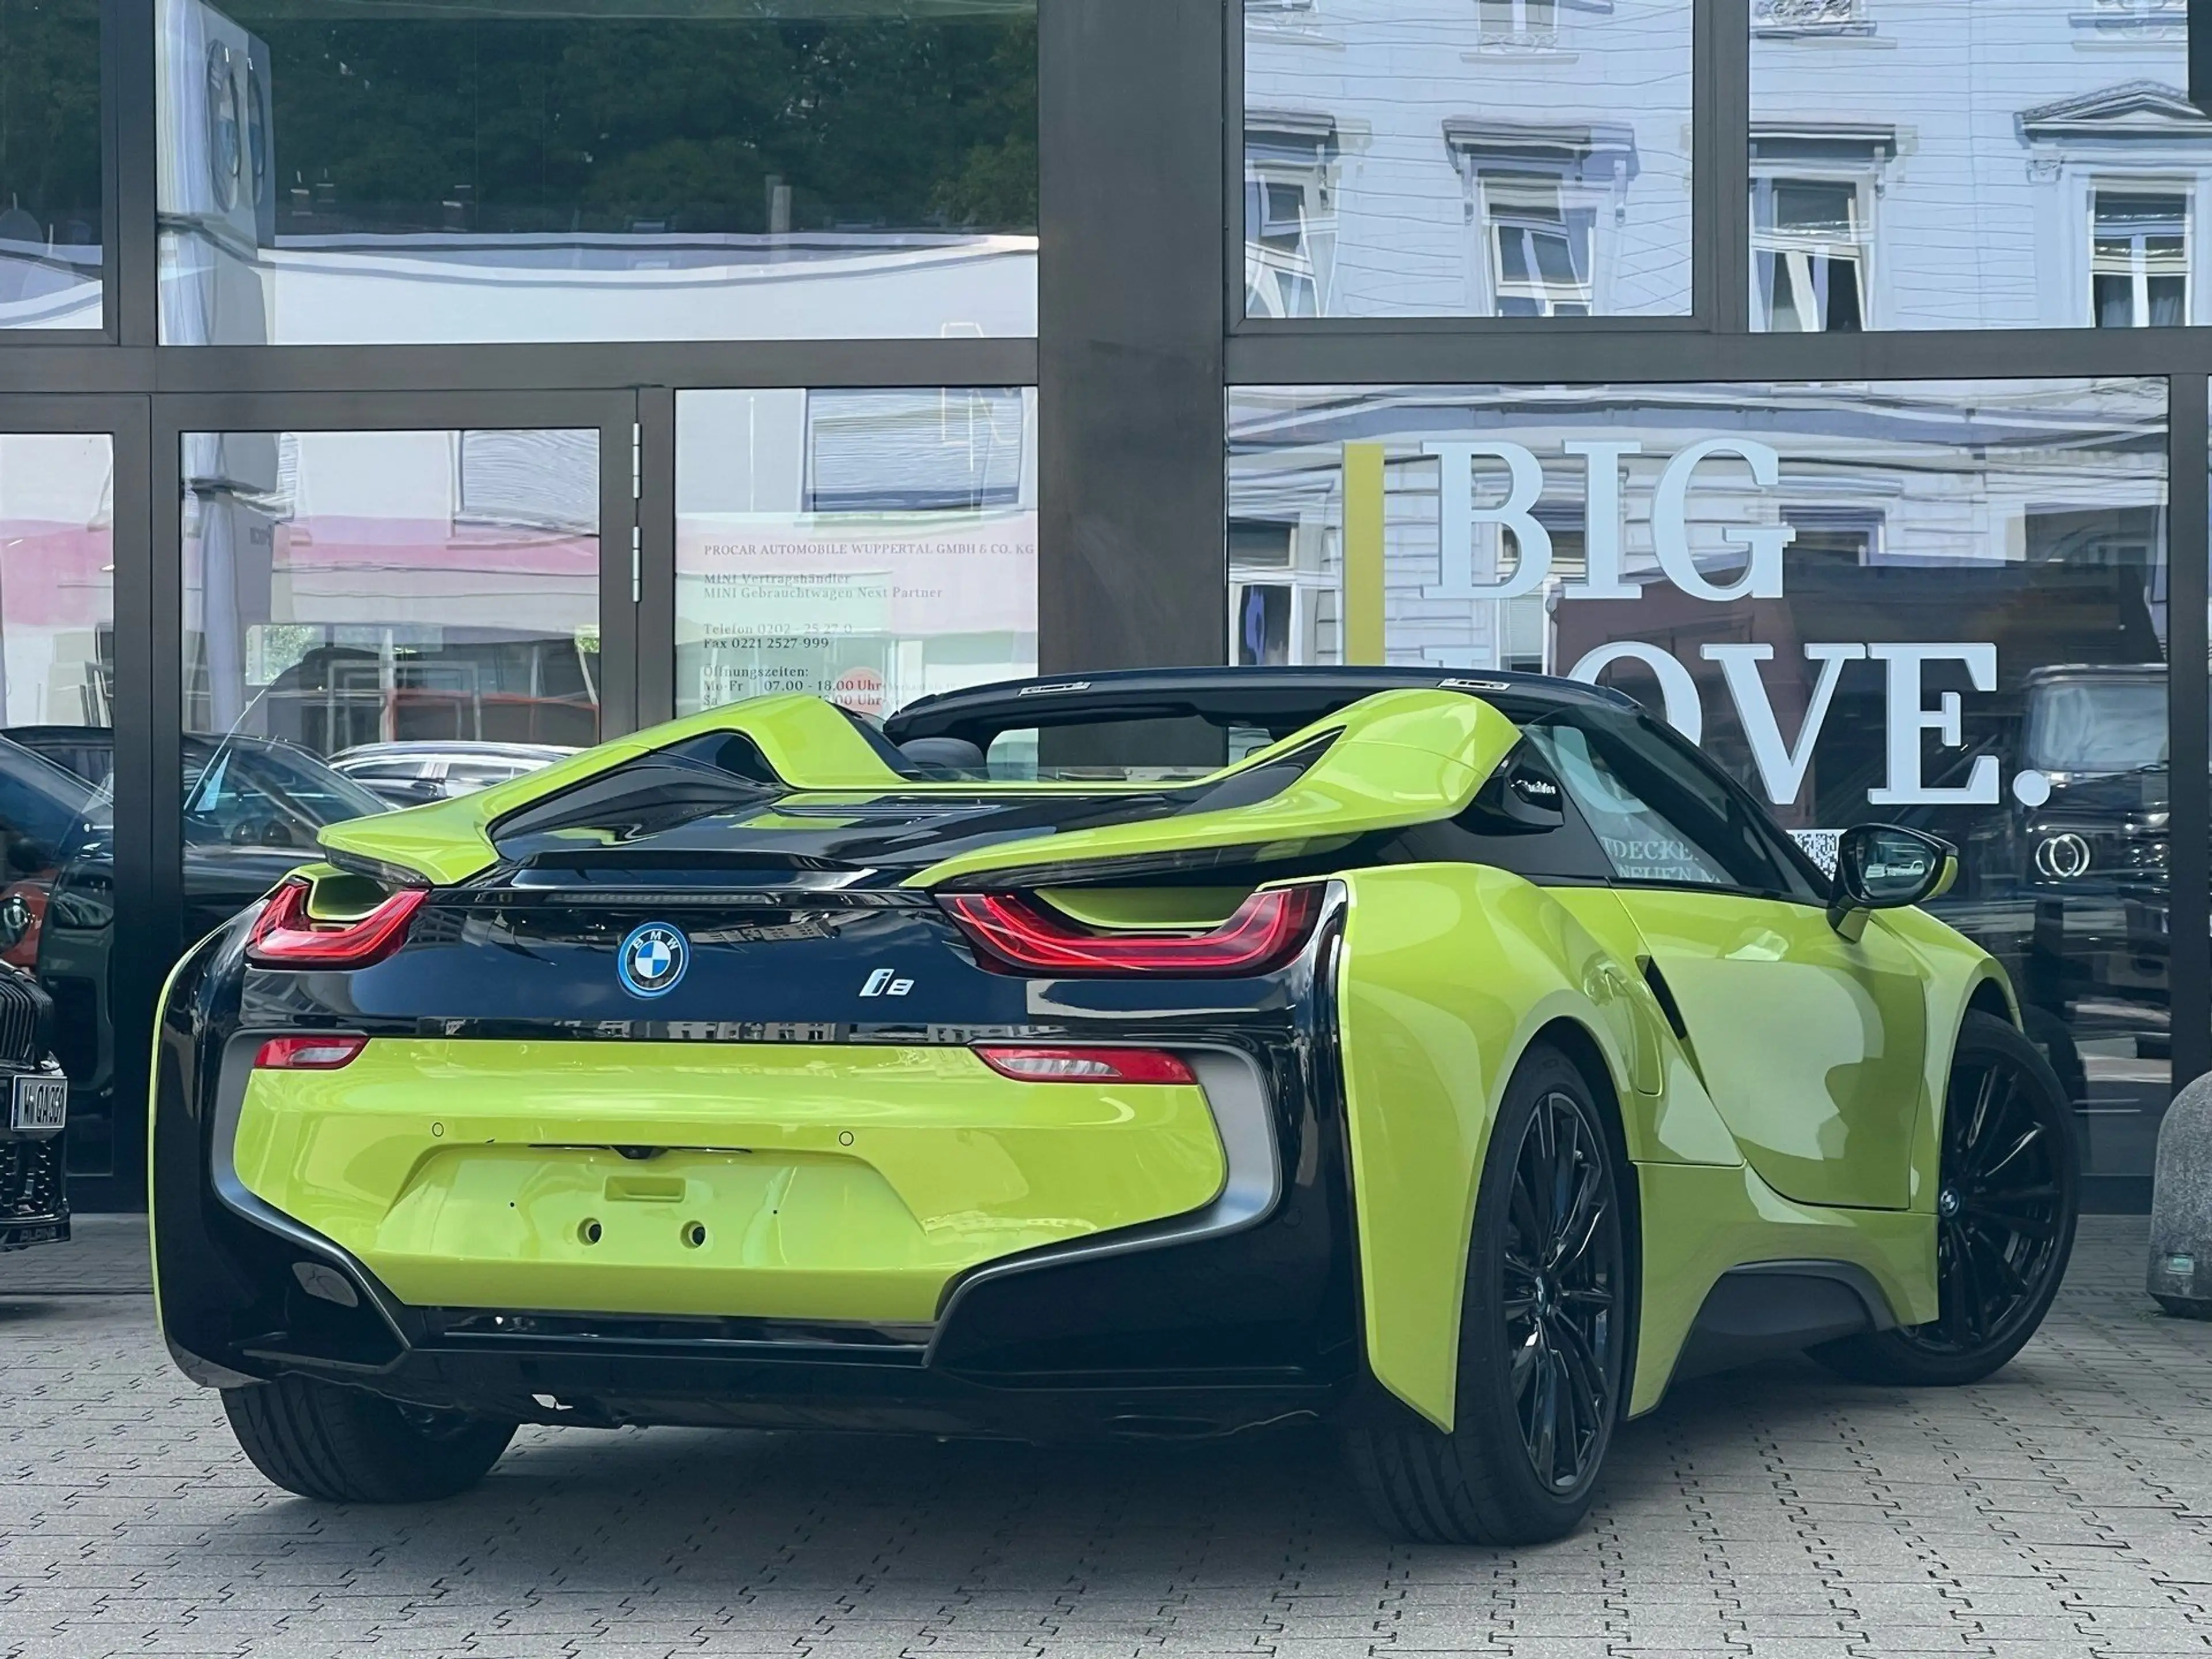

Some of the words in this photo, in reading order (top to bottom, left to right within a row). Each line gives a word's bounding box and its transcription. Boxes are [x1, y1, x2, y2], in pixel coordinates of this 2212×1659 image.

[1420, 438, 1796, 601] BIG
[704, 544, 756, 555] PROCAR
[760, 543, 847, 555] AUTOMOBILE
[851, 543, 933, 555] WUPPERTAL
[936, 543, 975, 555] GMBH
[979, 544, 987, 554] &
[990, 543, 1012, 555] CO.
[1016, 544, 1034, 555] KG
[704, 573, 737, 584] MINI
[741, 573, 851, 586] Vertragshändler
[704, 588, 737, 599] MINI
[741, 586, 853, 601] Gebrauchtwagen
[857, 587, 887, 599] Next
[892, 586, 943, 598] Partner
[703, 623, 753, 634] Telefon
[757, 623, 791, 634] 0202
[703, 638, 728, 649] Fax
[732, 637, 762, 649] 0221
[703, 664, 809, 679] Öffnungszeiten:
[764, 680, 803, 691] 07.00
[817, 680, 854, 691] 18.00
[858, 680, 882, 691] Uhr
[703, 695, 718, 706] Sa
[858, 694, 882, 706] Uhr
[1420, 641, 2051, 806] OVE.
[632, 930, 679, 950] BMW
[859, 968, 915, 997] i8
